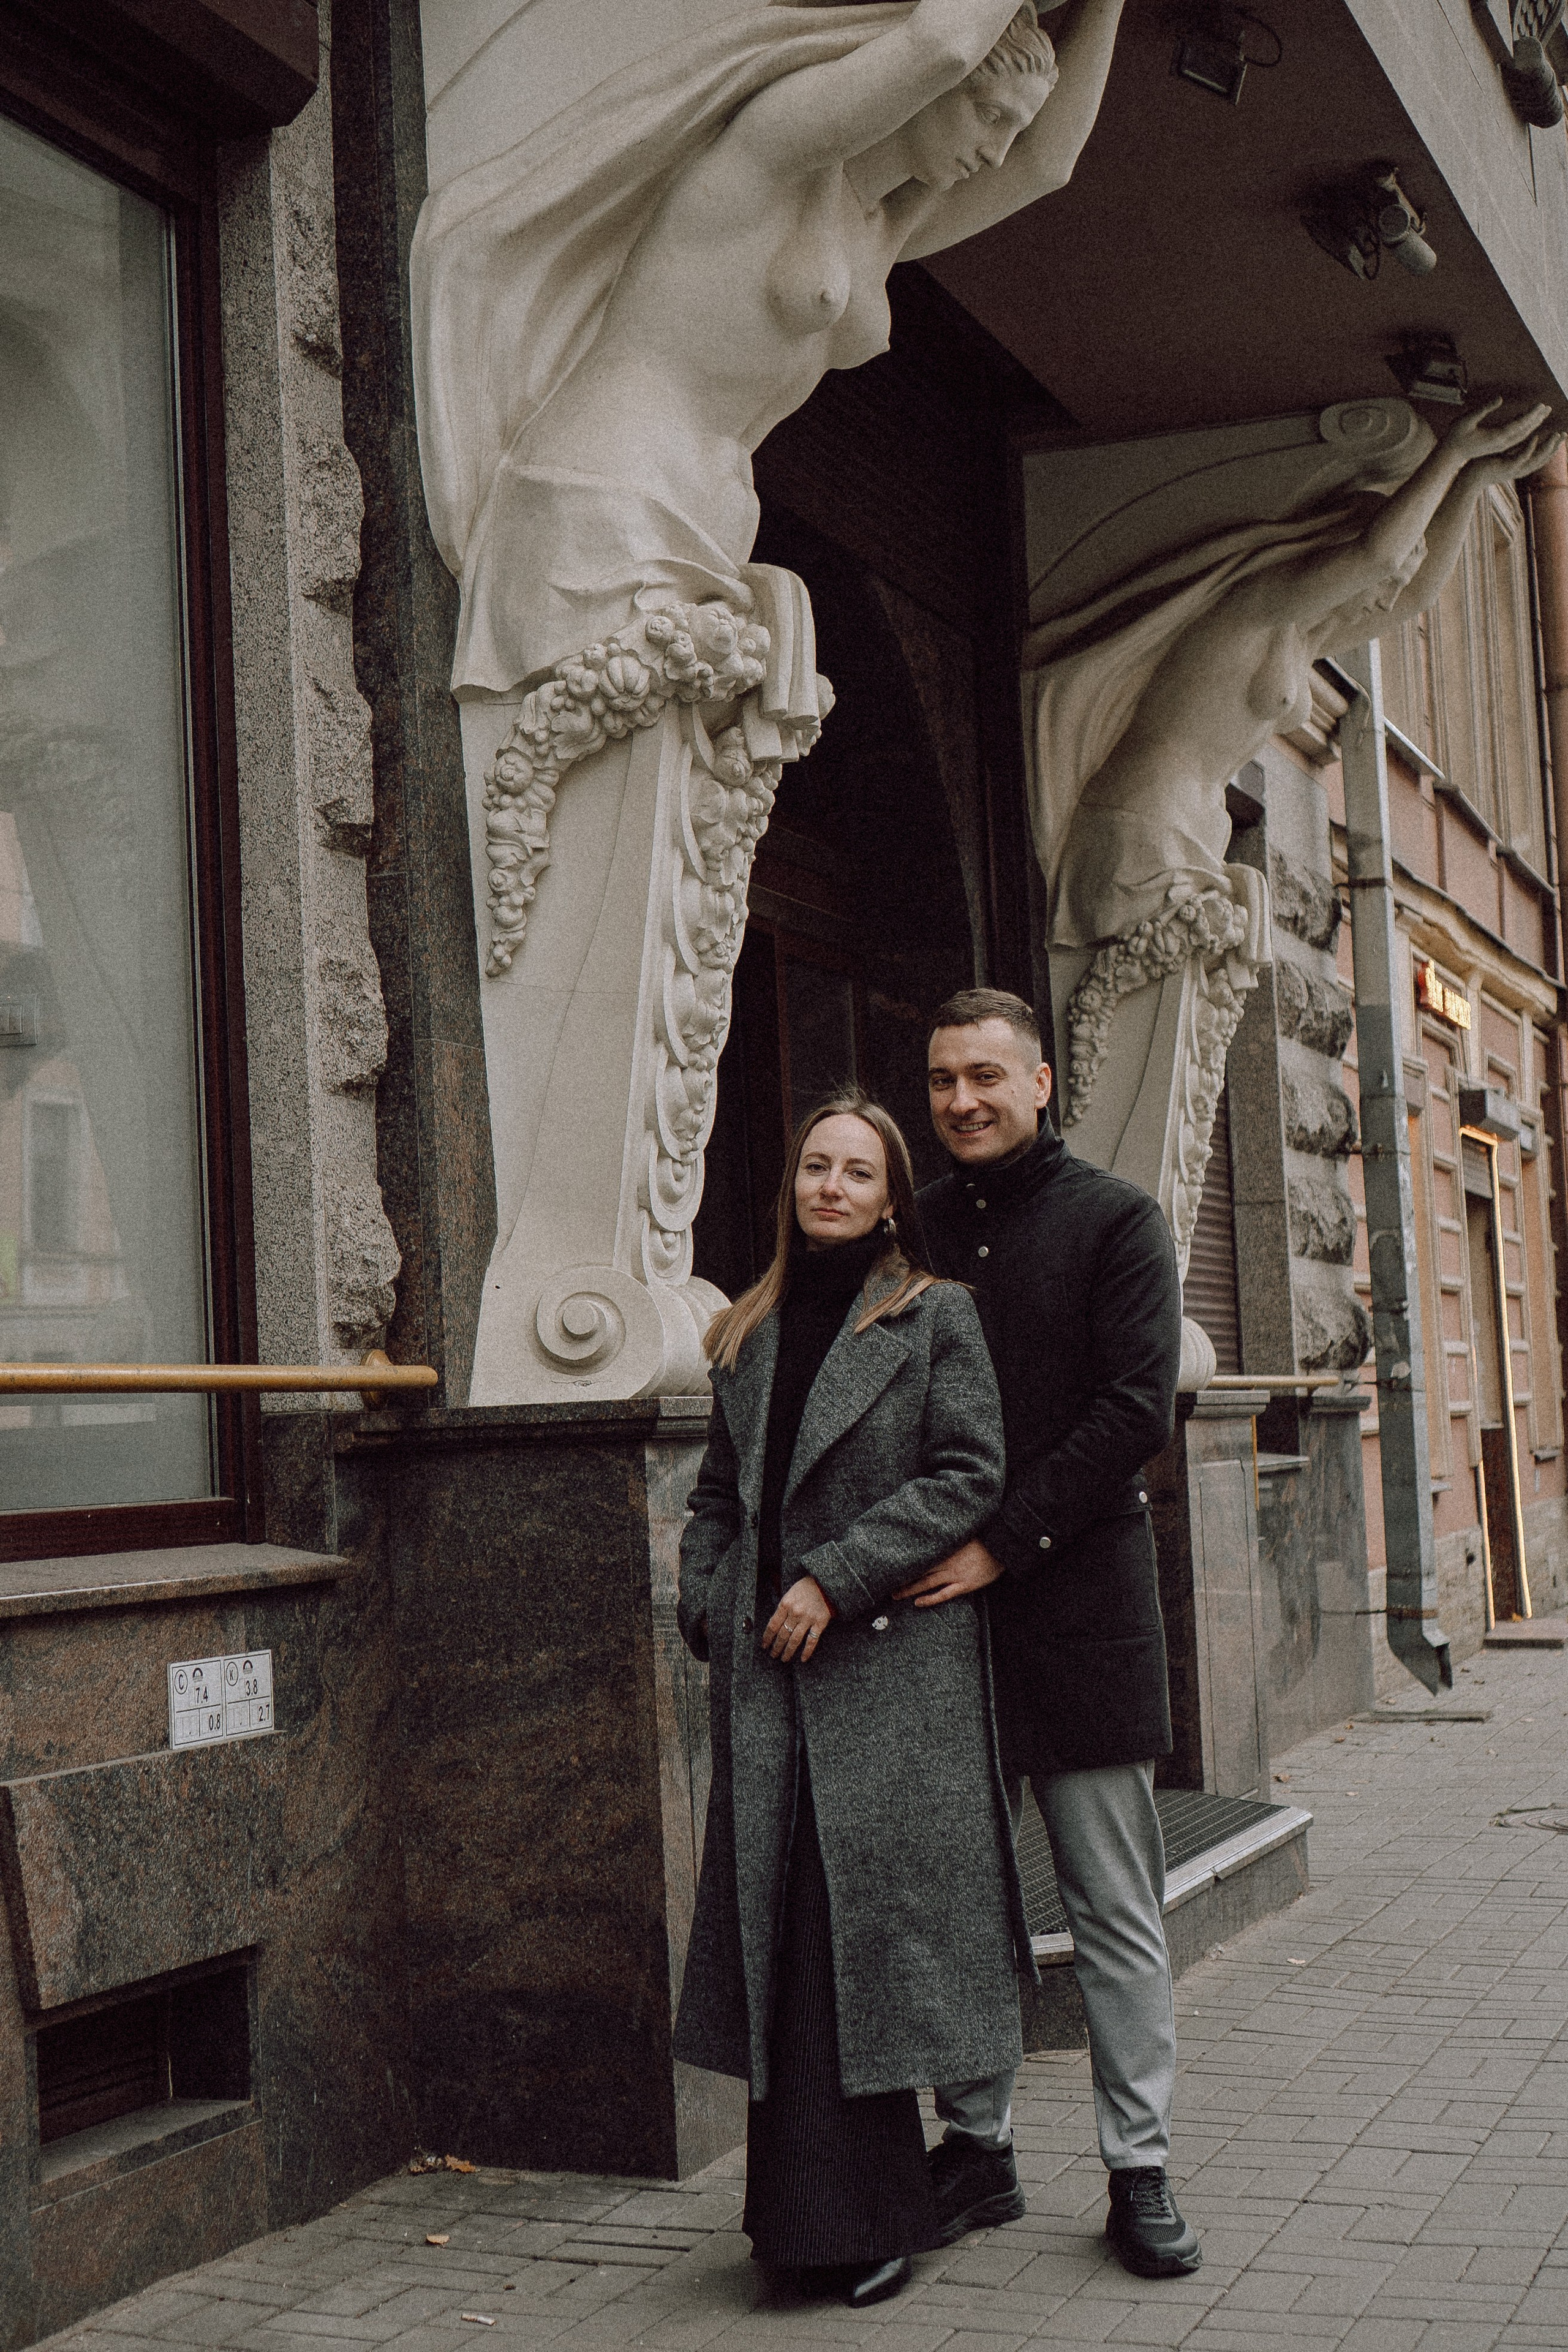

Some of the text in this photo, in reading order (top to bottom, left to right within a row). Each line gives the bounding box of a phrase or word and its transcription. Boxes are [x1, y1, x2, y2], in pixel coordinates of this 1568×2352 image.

[195, 1686, 208, 1704] 7.4
[246, 1678, 258, 1696] 3.8
[209, 1713, 221, 1731] 0.8
[258, 1704, 270, 1722] 2.7
